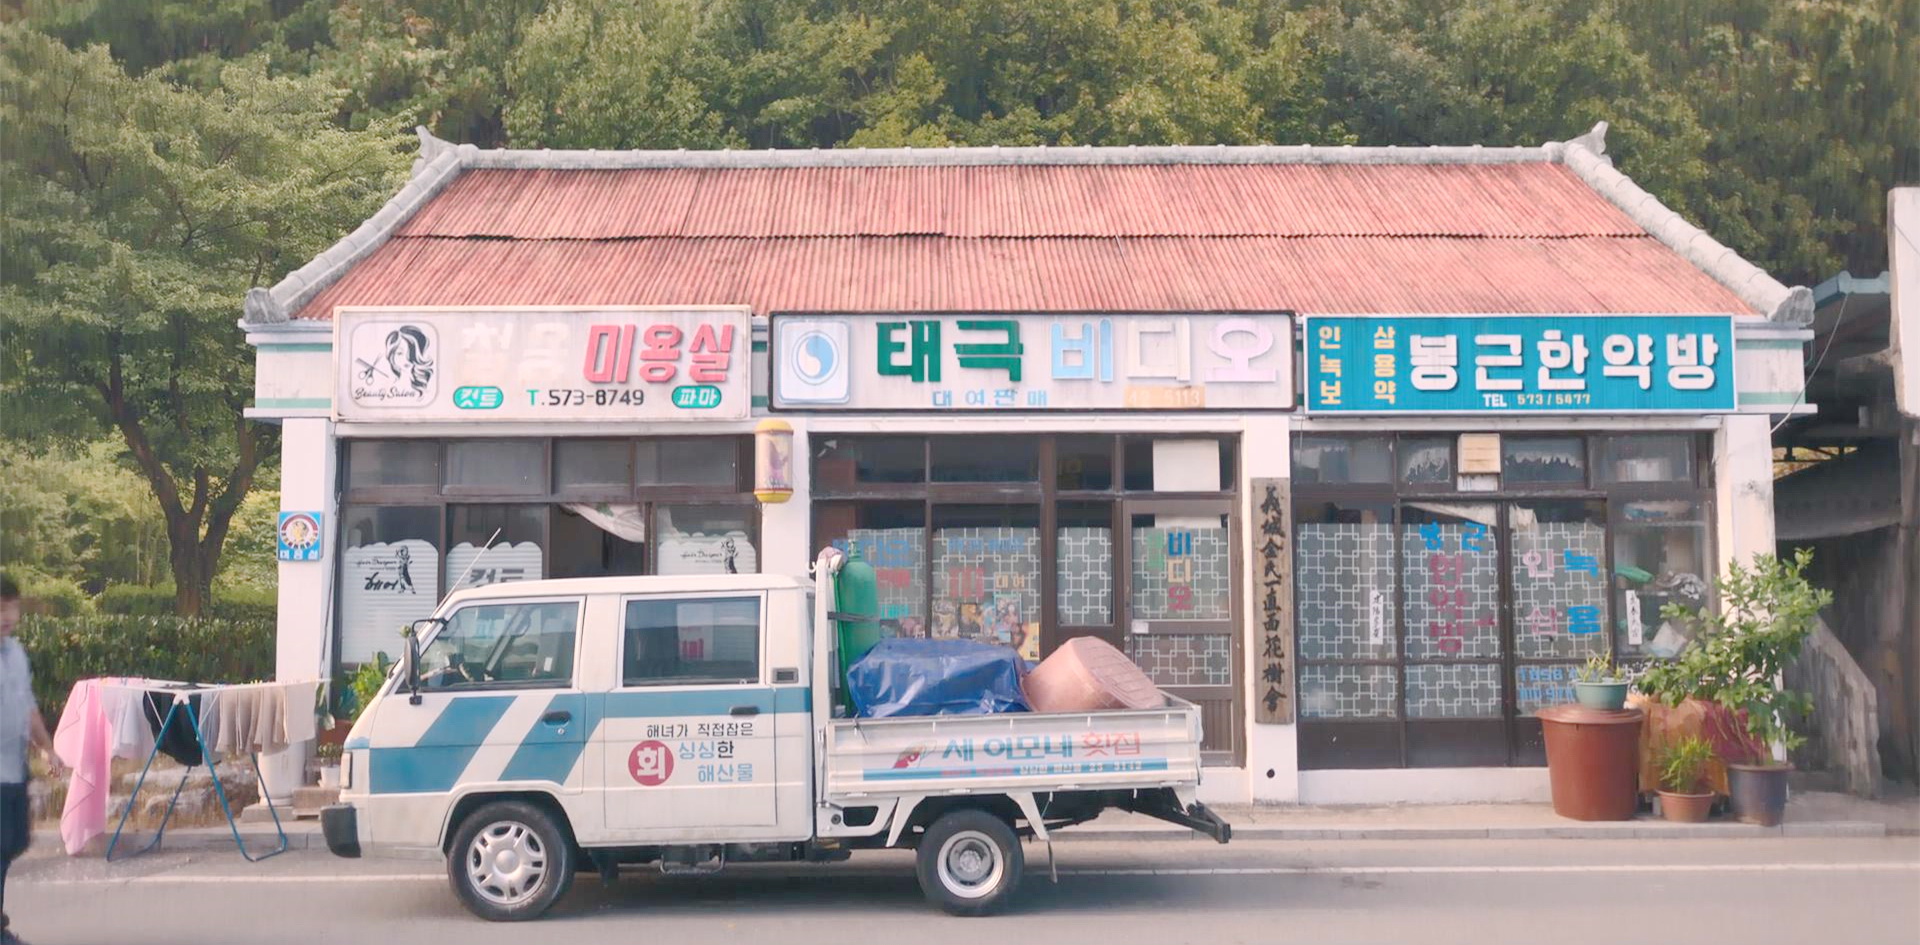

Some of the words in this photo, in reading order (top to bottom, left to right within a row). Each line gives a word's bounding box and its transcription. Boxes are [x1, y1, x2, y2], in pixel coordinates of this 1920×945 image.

[584, 324, 733, 383] 미용실
[876, 319, 1024, 382] 태극
[1050, 318, 1276, 382] 비디오
[1409, 329, 1719, 390] 봉근한약방
[355, 387, 386, 401] Beauty
[387, 386, 415, 398] Salon
[460, 388, 499, 407] 컷트
[527, 389, 644, 406] T.573-8749
[677, 388, 718, 406] 파마
[1482, 394, 1508, 407] TEL
[364, 571, 399, 591] 헤어
[1167, 532, 1192, 611] 비디오
[647, 723, 688, 738] 해녀가
[697, 722, 753, 737] 직접잡은
[679, 740, 734, 759] 싱싱한
[942, 738, 974, 761] 세
[1081, 732, 1141, 757] 횟집
[636, 746, 666, 779] 회
[697, 763, 753, 782] 해산물
